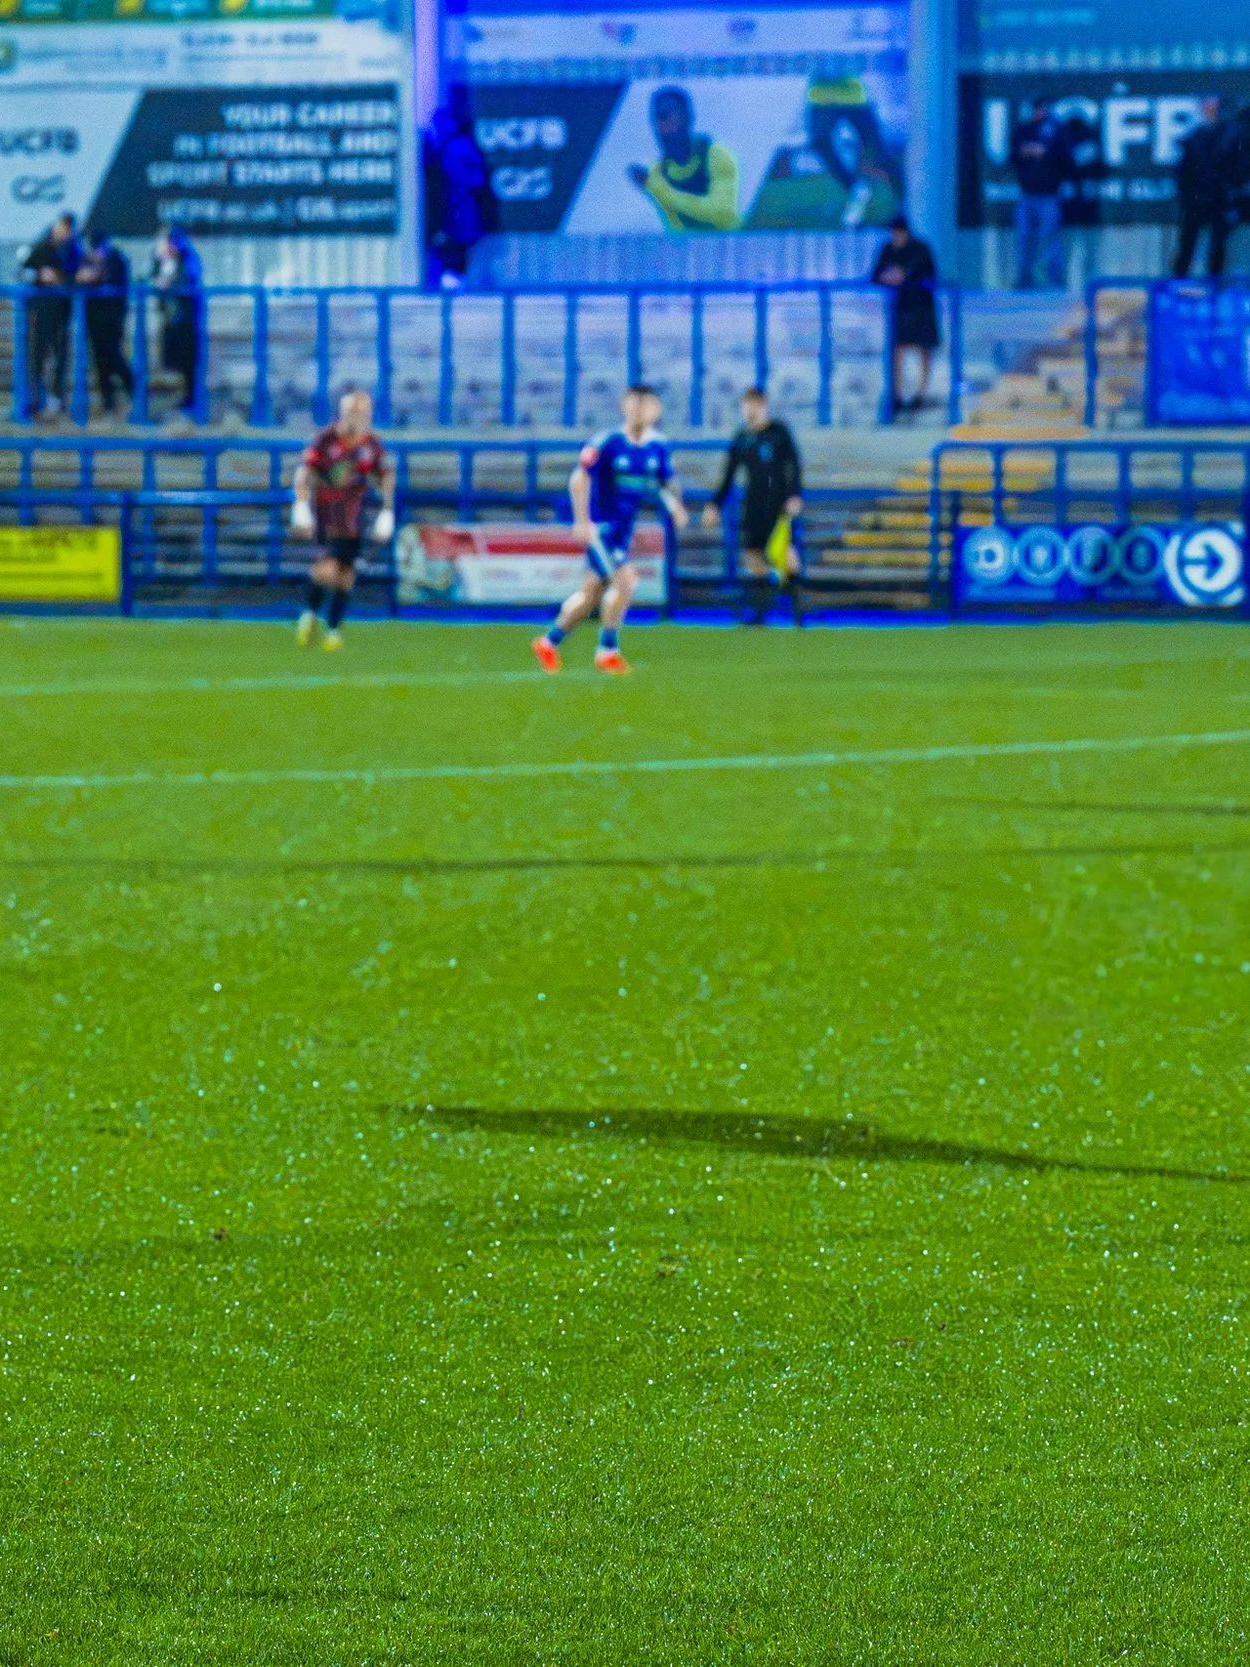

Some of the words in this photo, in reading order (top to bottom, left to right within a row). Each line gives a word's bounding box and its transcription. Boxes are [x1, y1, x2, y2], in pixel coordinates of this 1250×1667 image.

[222, 102, 291, 126] YOUR
[297, 100, 396, 125] CAREER
[174, 134, 202, 156] IN
[206, 132, 331, 156] FOOTBALL
[339, 131, 397, 155] AND
[474, 117, 567, 151] UCFB
[147, 160, 228, 187] SPORT
[232, 160, 323, 186] STARTS
[328, 159, 393, 184] HERE
